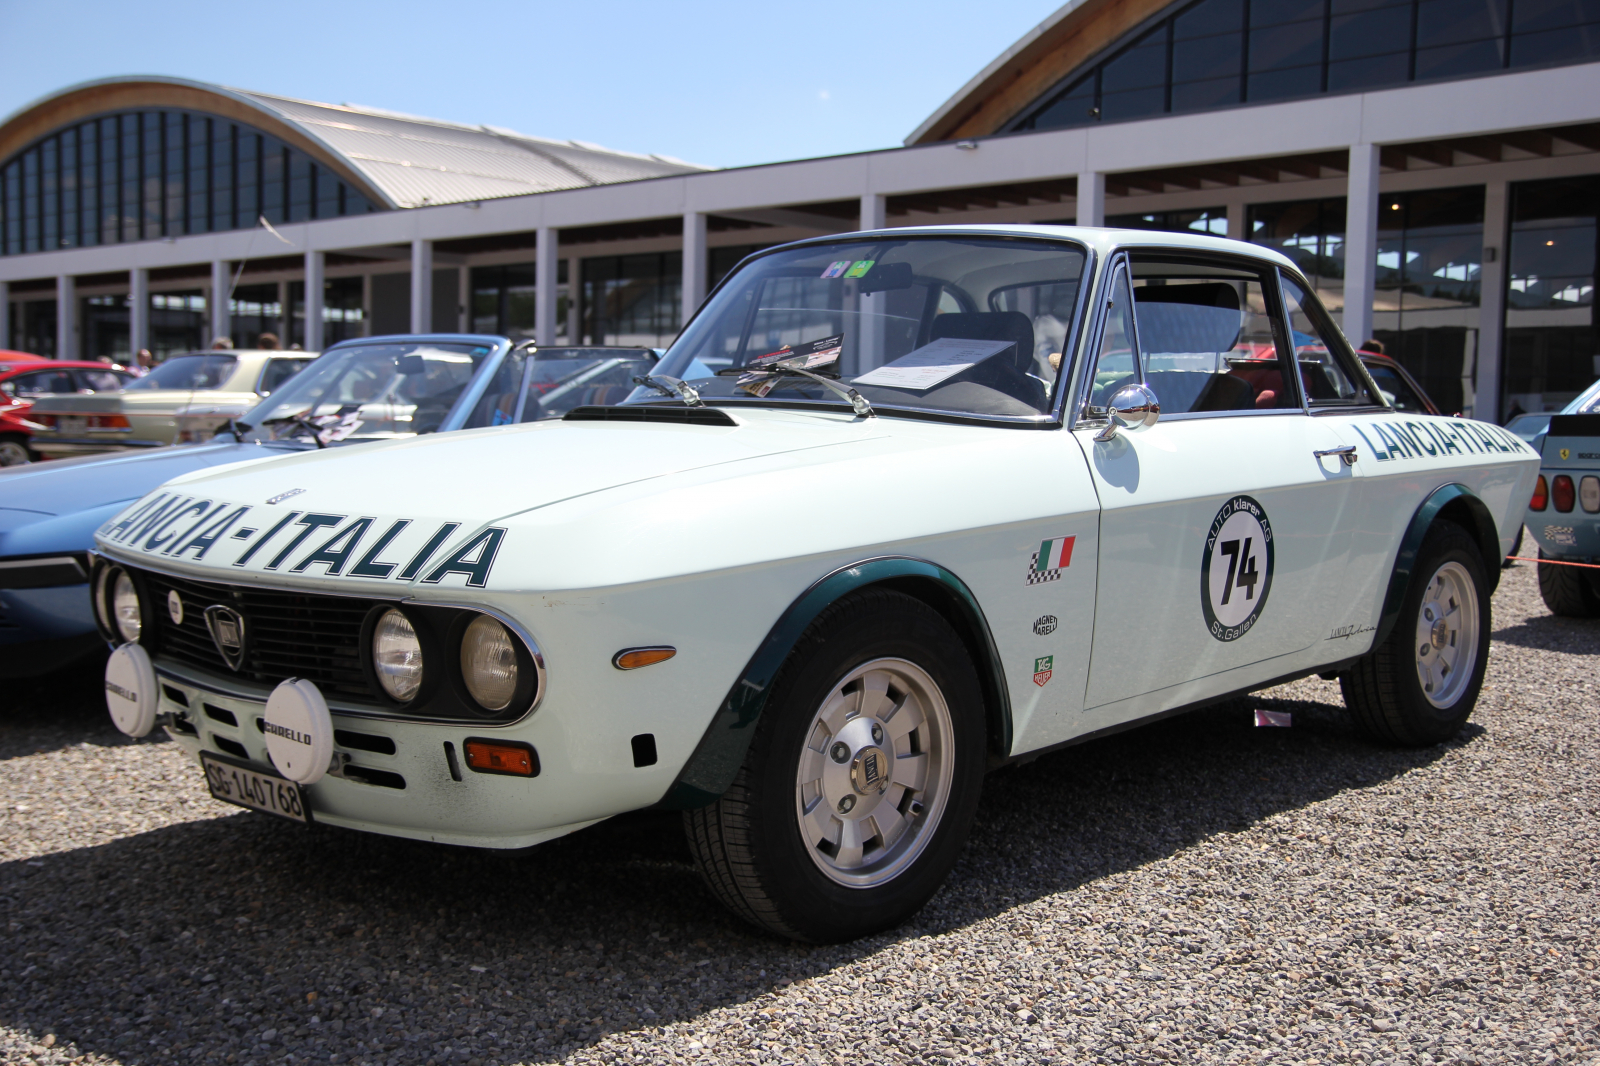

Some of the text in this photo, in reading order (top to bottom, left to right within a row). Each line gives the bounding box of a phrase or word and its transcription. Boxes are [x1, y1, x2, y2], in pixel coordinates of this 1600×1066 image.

[1350, 421, 1530, 462] LANCIA-ITALIA
[1207, 498, 1272, 551] AUTO klarer AG
[1220, 537, 1258, 605] 74
[1034, 671, 1051, 685] HEUER
[1037, 657, 1051, 672] TAG
[264, 721, 311, 746] CARELLO
